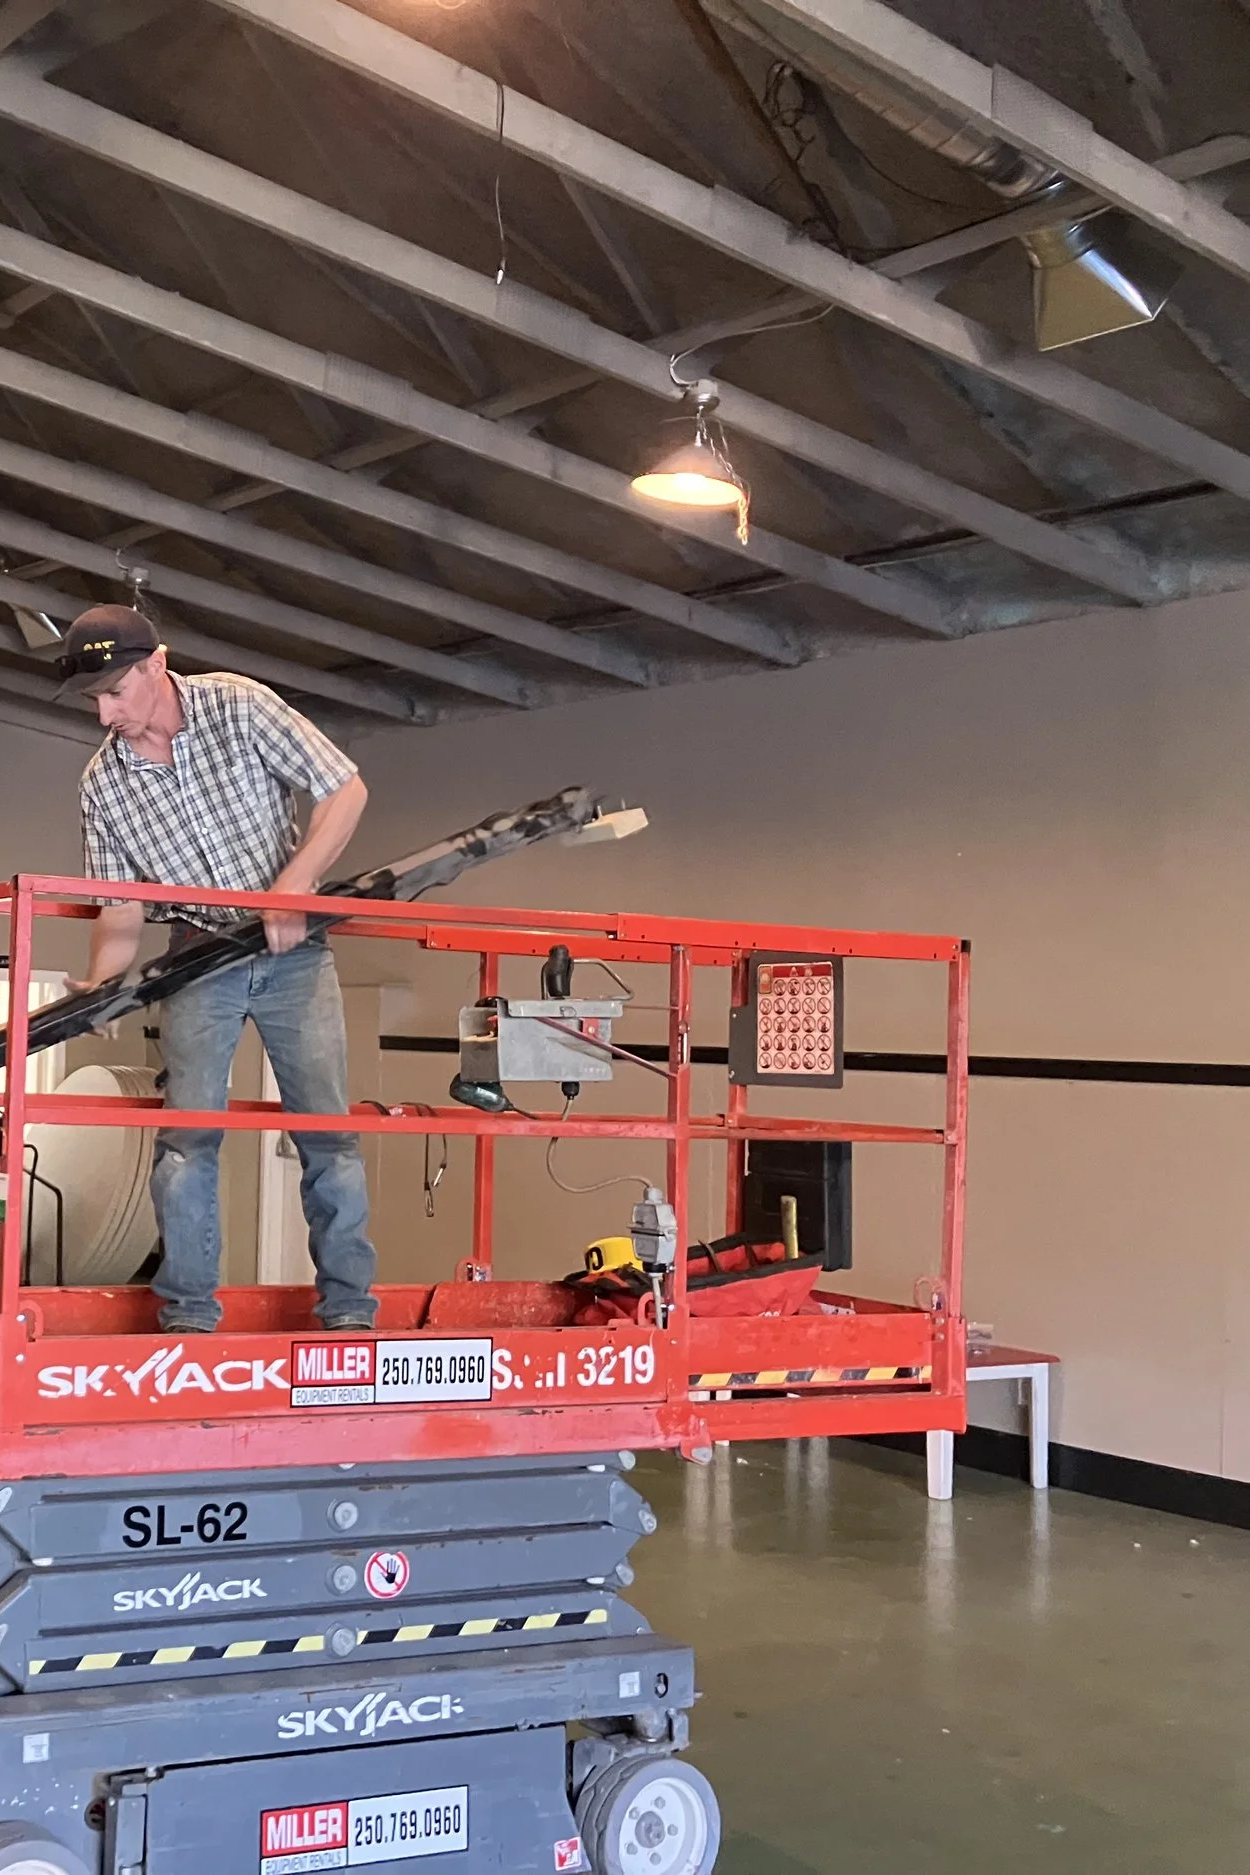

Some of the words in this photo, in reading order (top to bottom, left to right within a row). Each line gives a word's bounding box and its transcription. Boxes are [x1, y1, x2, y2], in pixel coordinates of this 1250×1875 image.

[297, 1346, 370, 1381] MILLER
[382, 1356, 485, 1386] 250.769.0960
[577, 1344, 654, 1387] 3219
[296, 1390, 337, 1404] EQUIPMENT
[338, 1388, 369, 1402] RENTALS
[122, 1501, 248, 1549] SL-62
[113, 1571, 268, 1611] SKYJACK
[277, 1692, 464, 1739] SKYJACK
[266, 1808, 343, 1851] MILLER
[355, 1804, 461, 1847] 250.769.0960
